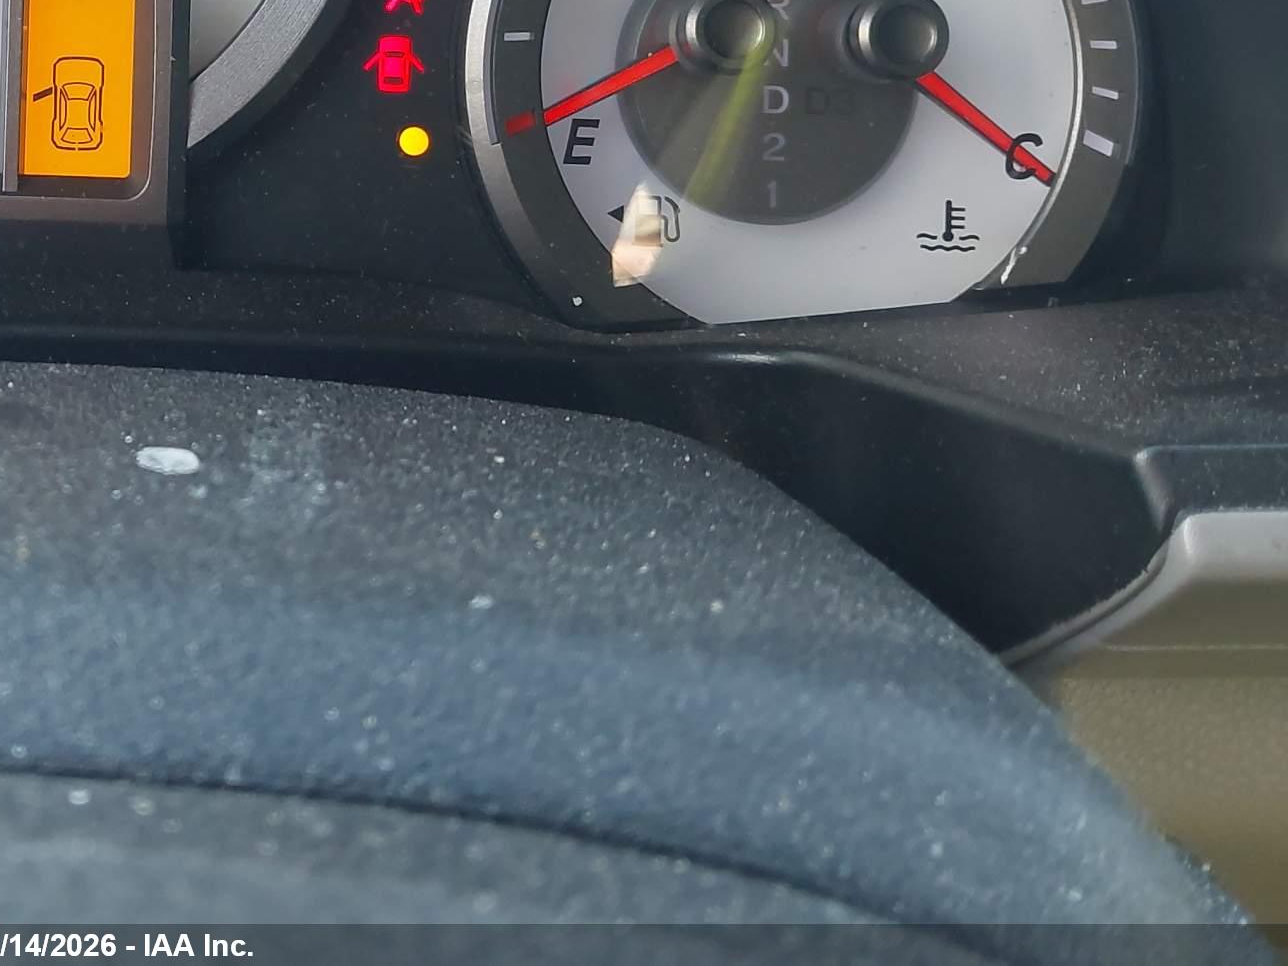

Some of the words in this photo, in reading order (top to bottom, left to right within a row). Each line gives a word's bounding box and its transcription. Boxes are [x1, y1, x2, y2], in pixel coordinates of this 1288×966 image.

[763, 85, 790, 115] D
[563, 118, 601, 166] E
[763, 132, 787, 162] 2
[1004, 133, 1044, 180] C
[767, 180, 779, 209] 1
